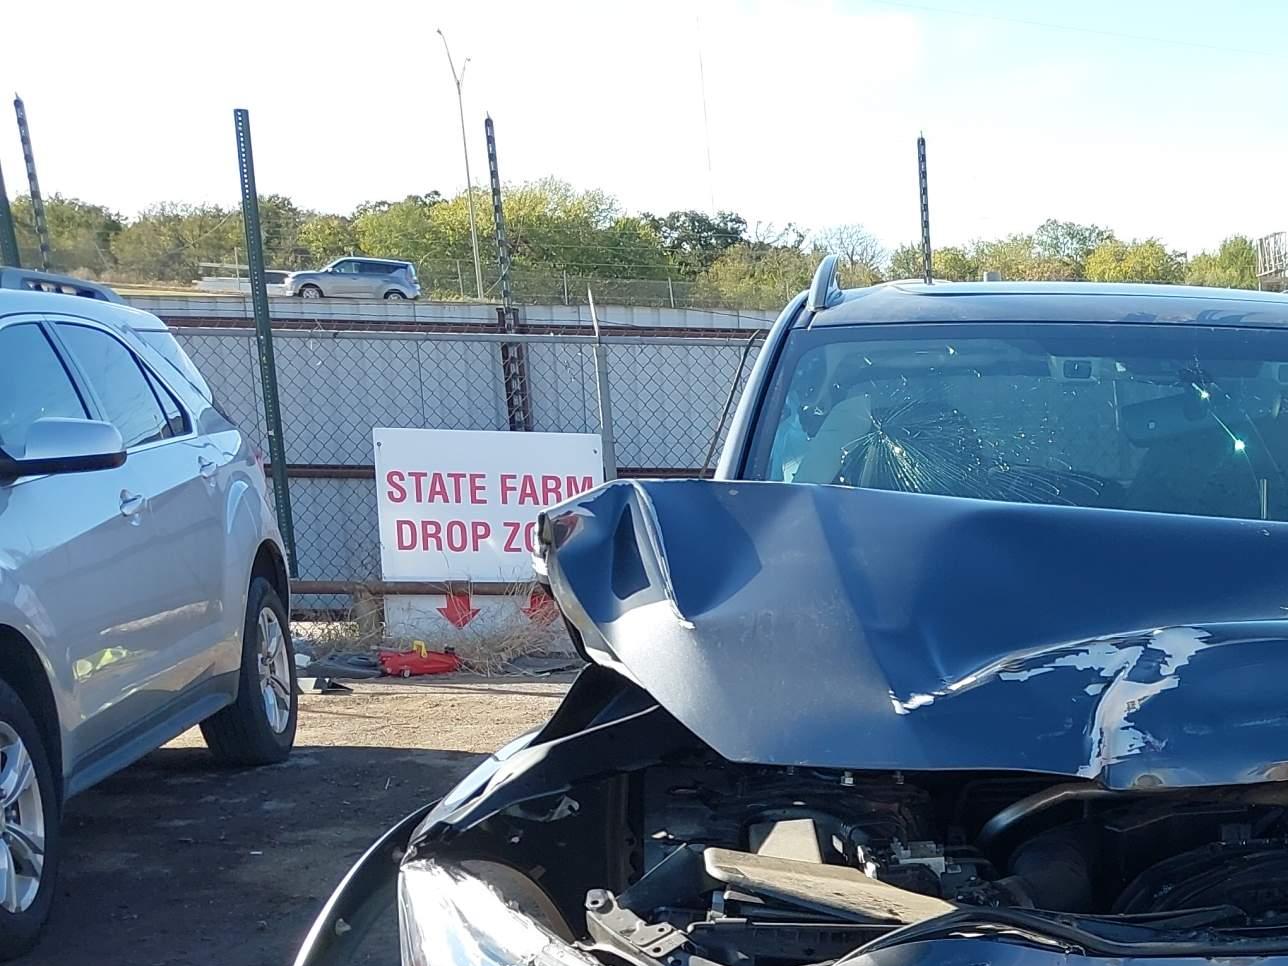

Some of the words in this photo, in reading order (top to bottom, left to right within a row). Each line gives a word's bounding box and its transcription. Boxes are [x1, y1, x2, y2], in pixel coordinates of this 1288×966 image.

[386, 470, 488, 505] STATE
[500, 474, 594, 506] FARM
[396, 519, 491, 553] DROP
